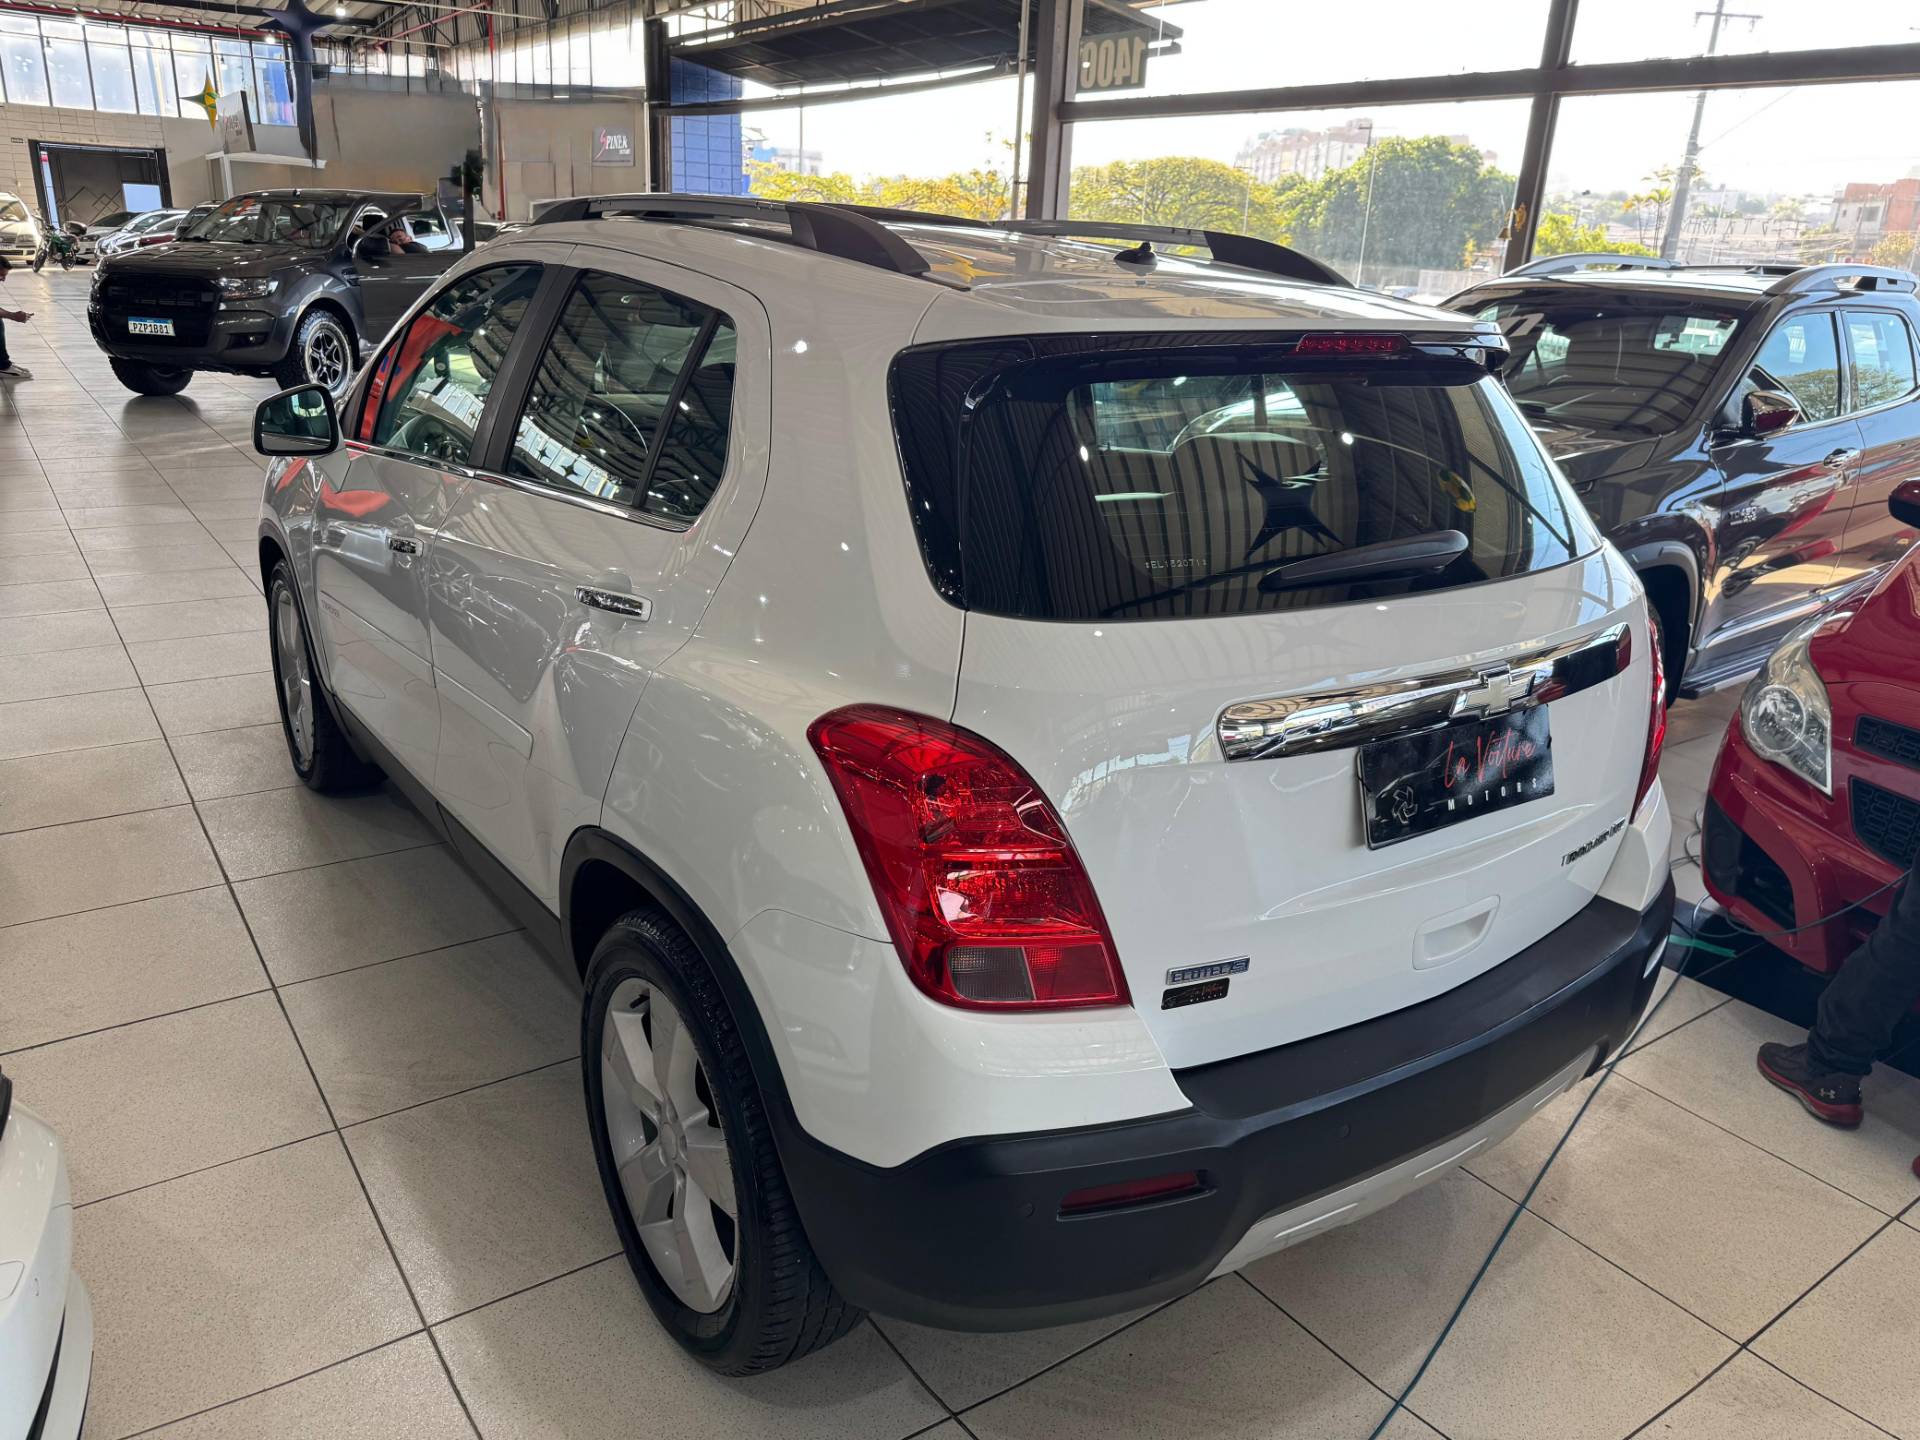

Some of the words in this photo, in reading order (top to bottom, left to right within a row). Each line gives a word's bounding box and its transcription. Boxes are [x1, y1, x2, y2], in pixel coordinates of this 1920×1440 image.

[132, 323, 170, 334] PZP1B81
[1444, 741, 1469, 788] La
[1476, 728, 1535, 783] Voiture
[1448, 778, 1537, 811] MOTORS
